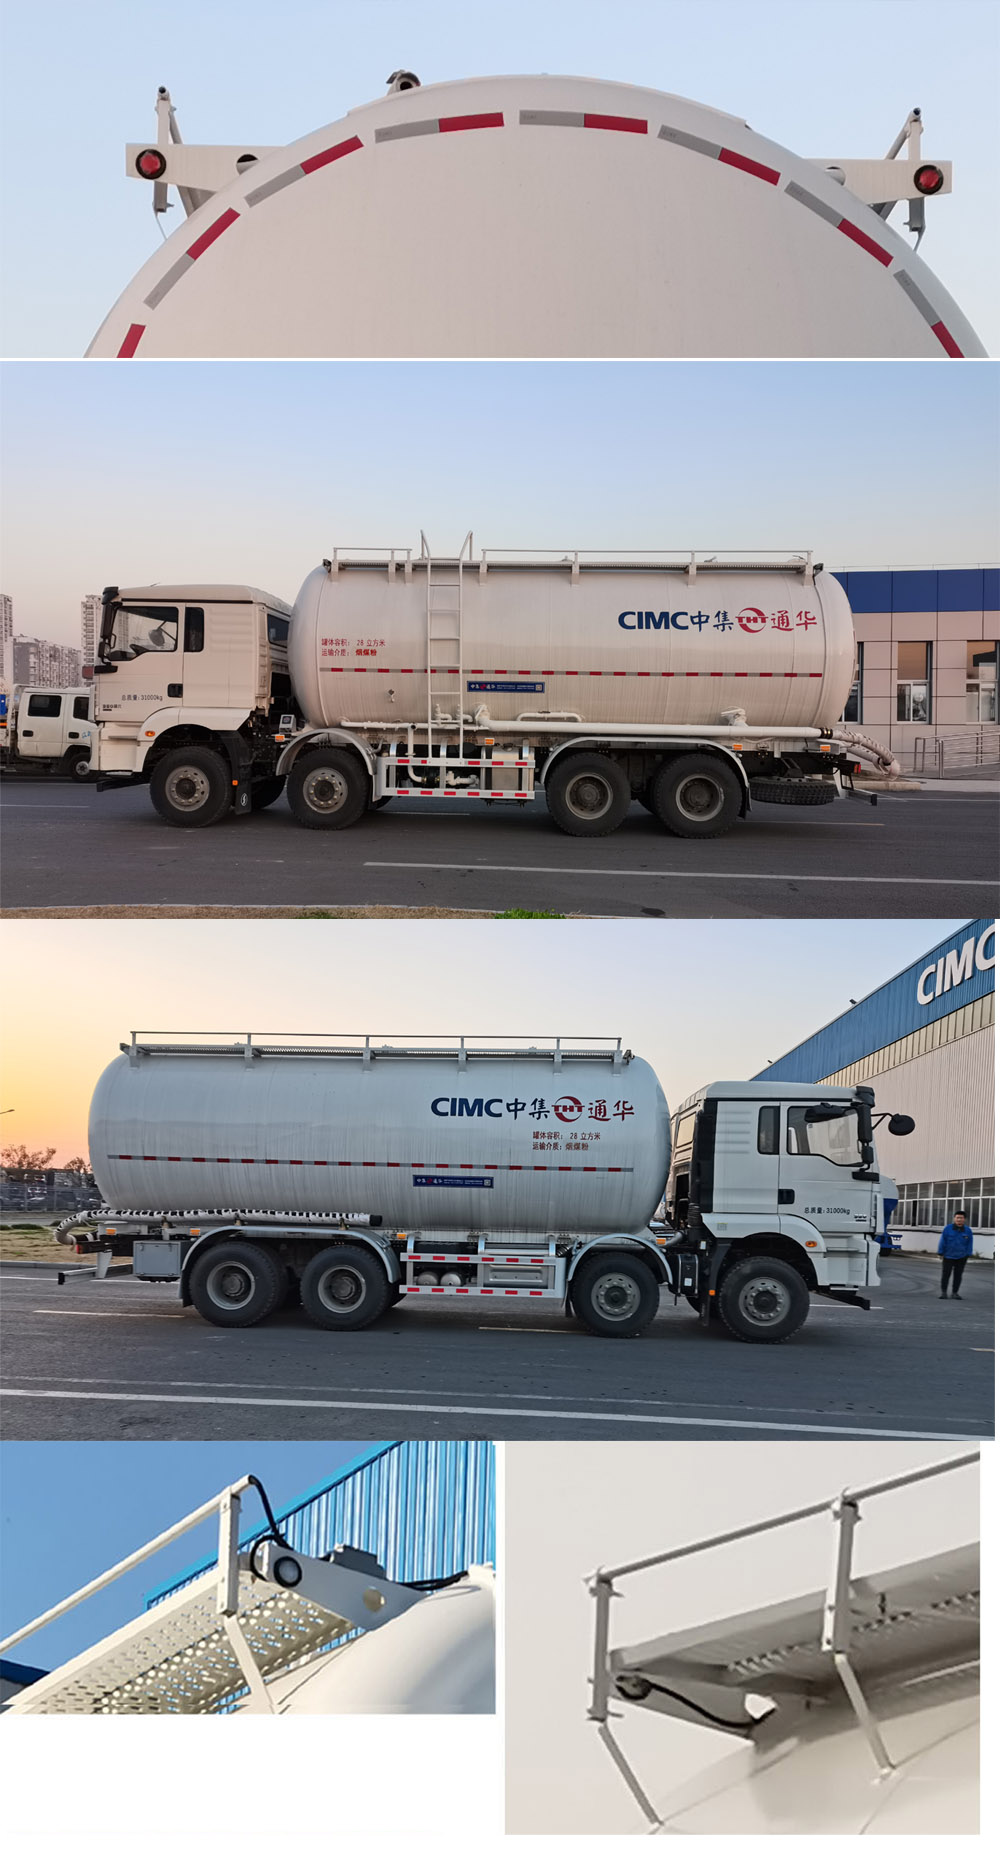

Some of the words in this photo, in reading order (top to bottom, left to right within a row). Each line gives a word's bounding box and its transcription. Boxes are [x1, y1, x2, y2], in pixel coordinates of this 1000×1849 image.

[618, 611, 689, 630] CIMC
[690, 610, 734, 632] 中集
[771, 610, 817, 632] 通华
[431, 1097, 503, 1118] CIMC
[506, 1098, 550, 1120] 中集
[588, 1099, 635, 1122] 通华
